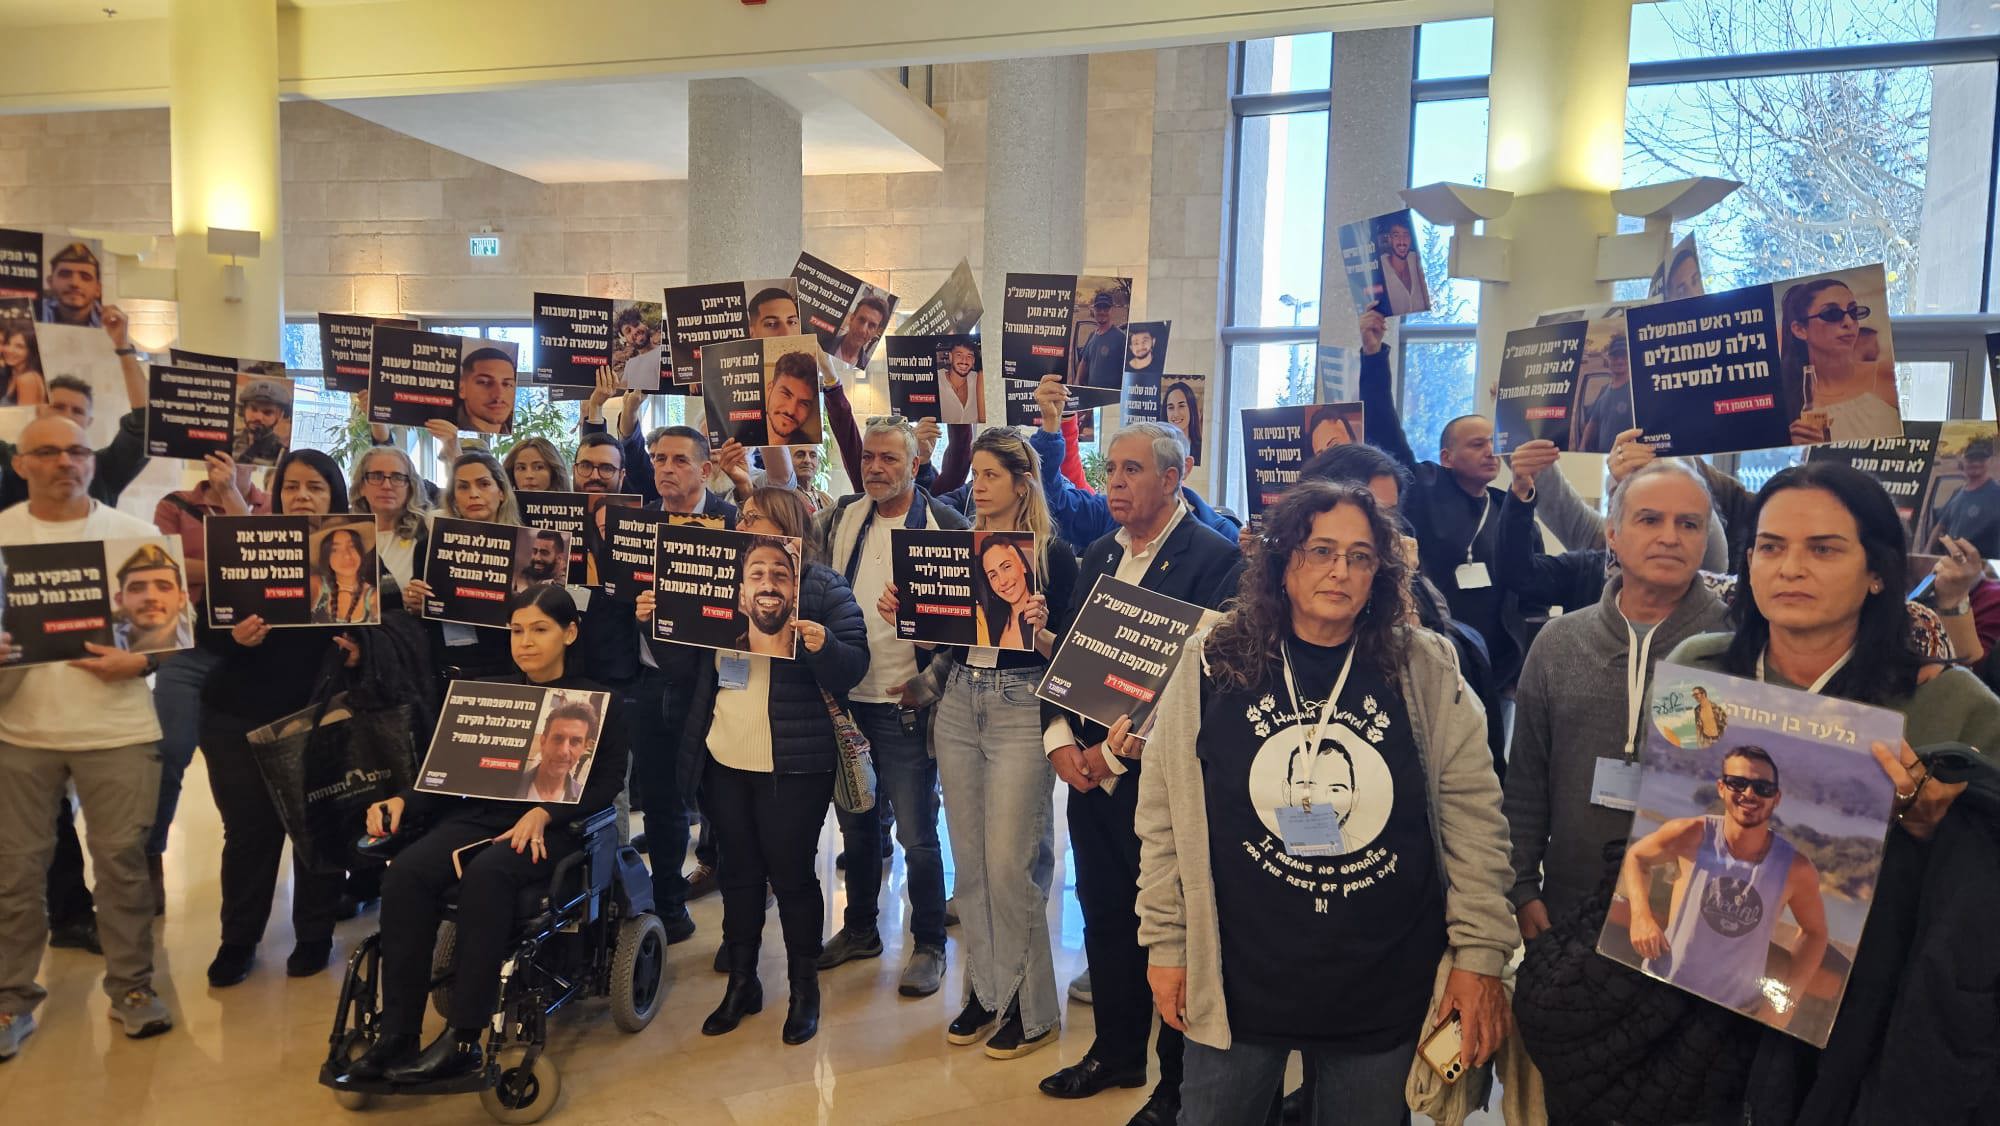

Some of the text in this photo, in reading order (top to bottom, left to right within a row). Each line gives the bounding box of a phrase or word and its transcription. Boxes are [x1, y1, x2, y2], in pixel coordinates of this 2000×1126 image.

[1007, 287, 1071, 302] איך ייתכן שהשב"כ
[702, 296, 741, 310] איך ייתכן
[541, 306, 608, 320] מי ייתן תשובות
[677, 312, 742, 327] שנלחמנו שעות
[1027, 306, 1069, 318] לא היה מוכן
[571, 323, 608, 335] לארוסתי
[1005, 322, 1066, 337] למתקפה החמורה?
[1638, 309, 1763, 341] מתי ראש הממשלה
[540, 335, 608, 350] שנשארה לבדה?
[677, 328, 745, 343] במיעוט מספרי?
[413, 344, 457, 359] איך ייתכן
[1505, 338, 1579, 359] איך ייתכן שהשב"כ
[1644, 332, 1766, 366] גילה שמחבלים
[382, 356, 456, 374] שנלחמנו שעות
[742, 353, 759, 366] למה
[909, 356, 917, 367] לא
[1525, 358, 1575, 379] לא היה מוכן
[1651, 361, 1769, 391] חדרו למסיבה?
[380, 371, 417, 386] מספרי?
[419, 376, 455, 390] במיעוט
[722, 372, 759, 386] מסיבה ליד
[732, 389, 760, 402] הגבול?
[1499, 380, 1571, 400] למתקפה החמורה?
[1731, 400, 1753, 412] גוטמן
[1754, 397, 1771, 407] תמר
[1253, 426, 1301, 442] איך נבטיח את
[1872, 439, 1930, 453] איך ייתכן
[1258, 447, 1302, 464] ביטחון ילדיי
[1880, 458, 1925, 473] לא היה
[1256, 468, 1276, 485] נוסף?
[526, 504, 584, 517] איך נבטיח את
[532, 518, 584, 531] ביטחון ילדיי
[618, 519, 645, 533] שלושת
[237, 530, 303, 543] מי אישר את
[444, 532, 511, 550] מדוע לא הגיעו
[613, 535, 641, 548] התצפית
[240, 547, 303, 561] המסיבה על
[437, 549, 509, 567] כוחות לחלץ את
[663, 541, 736, 560] עד 11:47 חיכיתי
[909, 546, 969, 561] איך נבטיח את
[221, 565, 304, 580] הגבול עם עזה?
[449, 566, 507, 584] מבלי הנובה?
[667, 561, 713, 577] התחננתי,
[714, 565, 735, 580] לכם,
[915, 563, 970, 579] ביטחון ילדיי
[13, 568, 100, 586] מי הפקיר את
[659, 578, 734, 599] למה לא הגעתם?
[909, 582, 970, 597] ממחדל נוסף?
[7, 587, 102, 606] מוצב נחל עוז?
[1094, 593, 1189, 636] איך ייתכן שהשב"כ
[1115, 625, 1179, 656] לא היה מוכן
[1072, 631, 1168, 678] למתקפה החמורה?
[449, 695, 536, 711] מדוע משפחתי הייתה
[457, 714, 532, 729] צריכה לנהל חקירה
[1725, 702, 1856, 745] גלעד בן יהודה
[452, 732, 527, 747] עצמאית על מותי?
[1275, 852, 1313, 873] MEANS
[1318, 866, 1335, 875] NO
[1340, 848, 1387, 875] WORRIES
[1242, 840, 1261, 861] FOR
[1262, 860, 1283, 878] THE
[1286, 876, 1317, 892] REST
[1321, 883, 1338, 892] OF
[1343, 876, 1375, 899] YOUR
